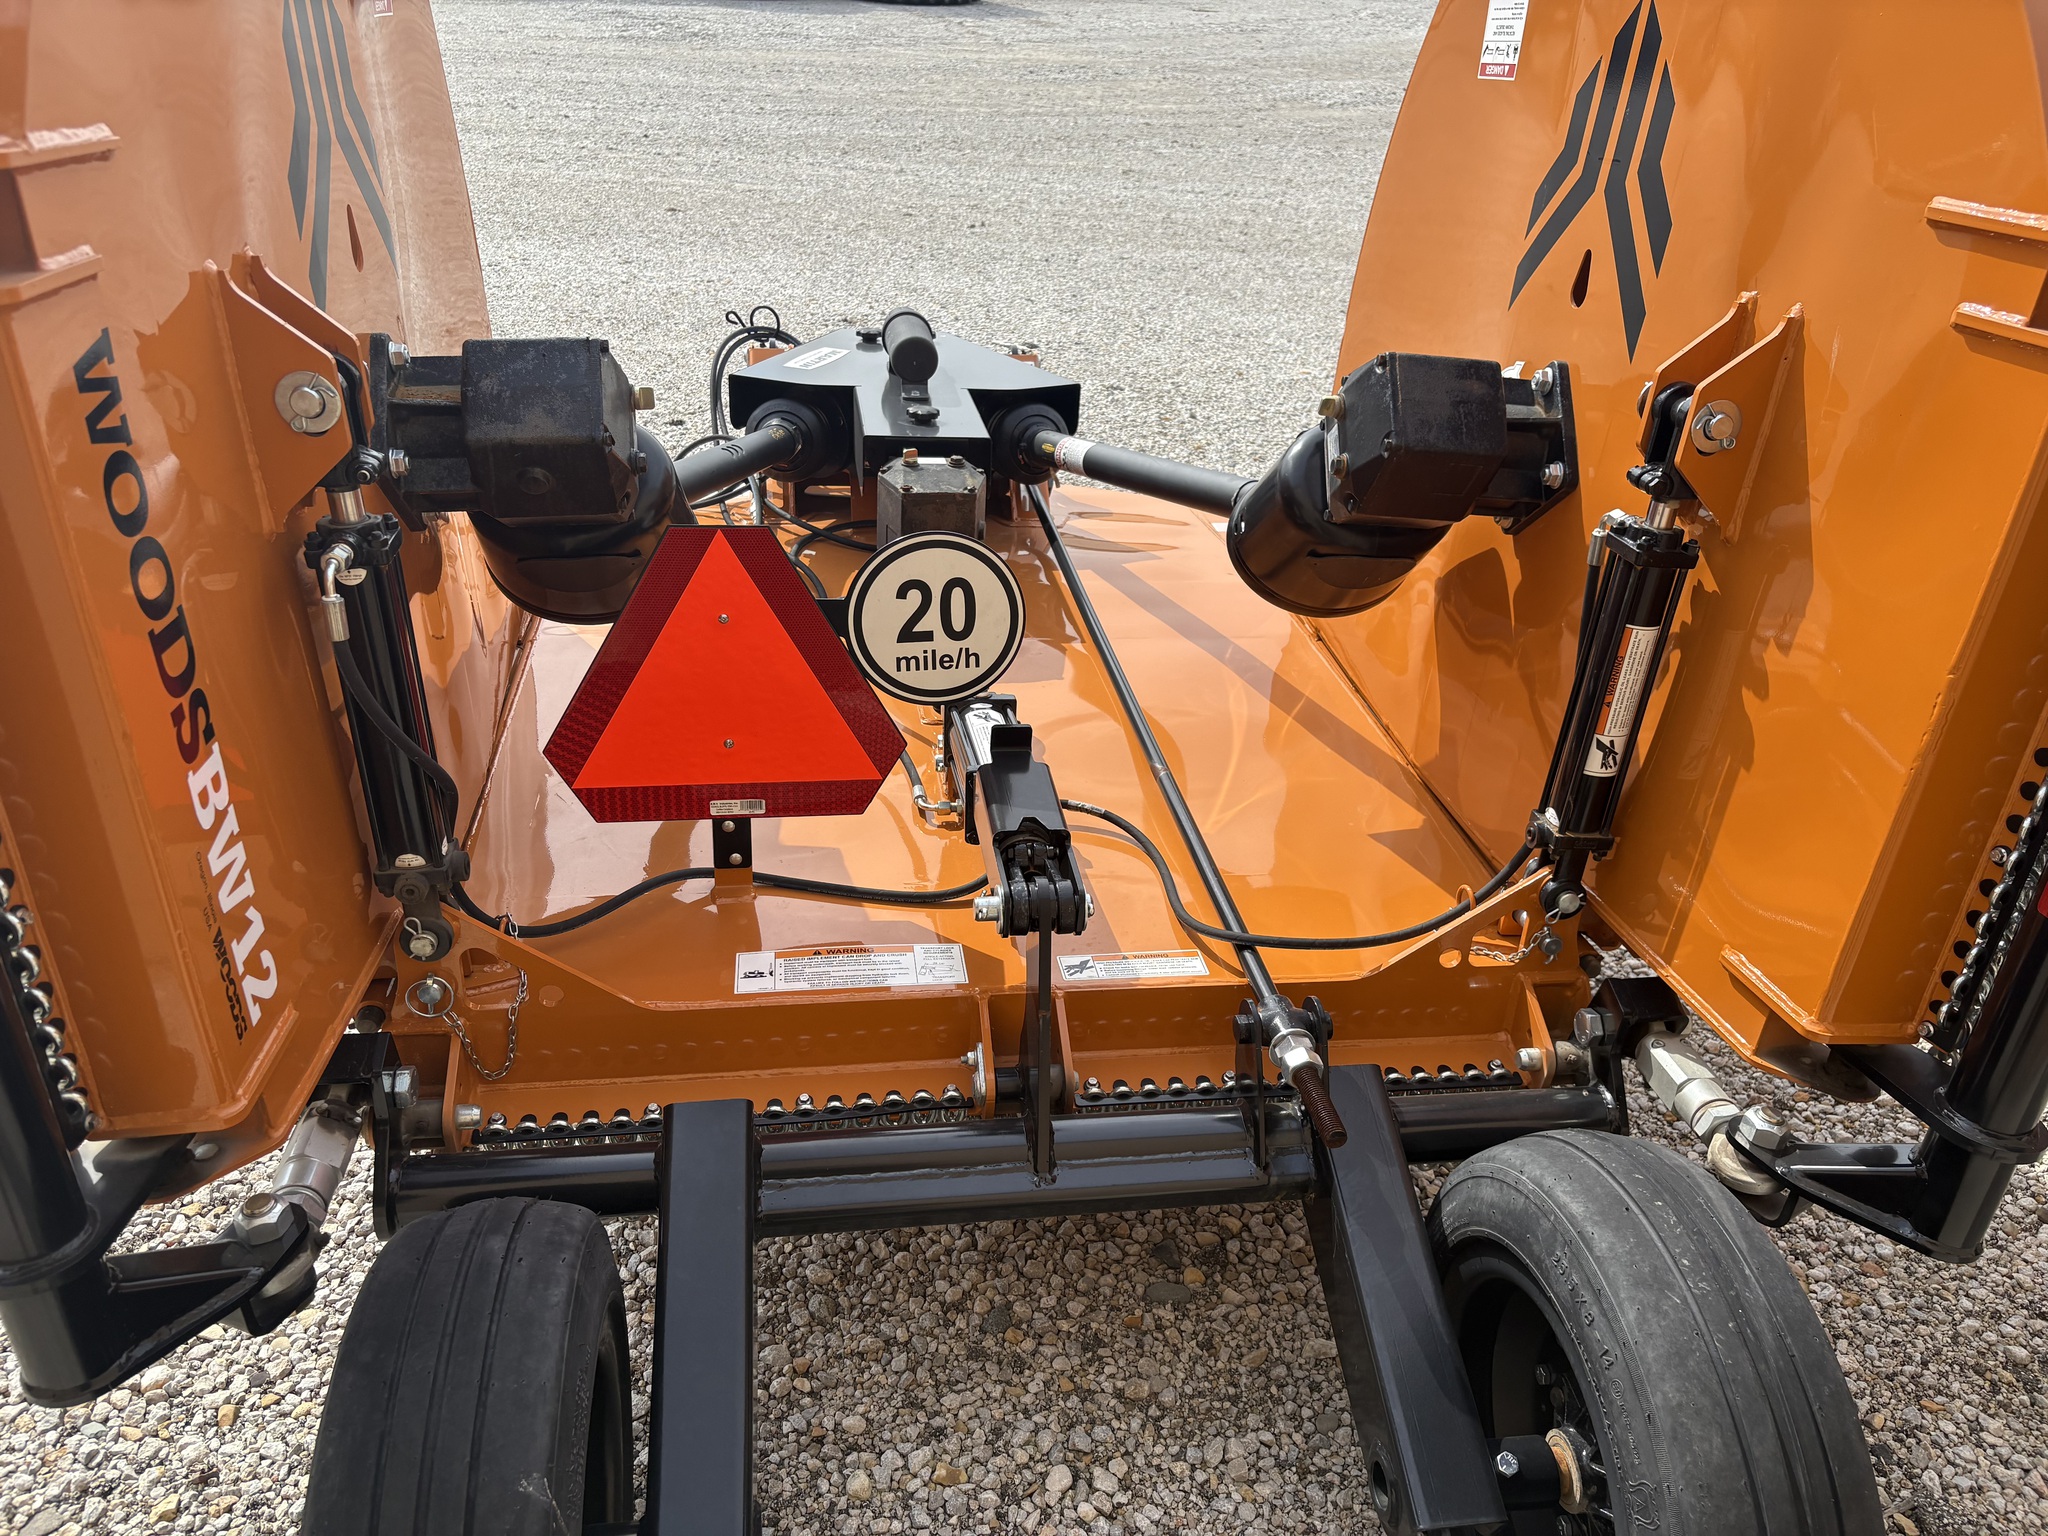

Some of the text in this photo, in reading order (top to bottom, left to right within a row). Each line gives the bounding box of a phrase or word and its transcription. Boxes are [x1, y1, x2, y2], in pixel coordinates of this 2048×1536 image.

[1486, 65, 1504, 75] DANGER
[896, 577, 976, 643] 20
[896, 647, 980, 672] mile/h
[1606, 655, 1624, 696] WARNING
[202, 907, 212, 932] USA
[213, 926, 248, 1041] WOODS
